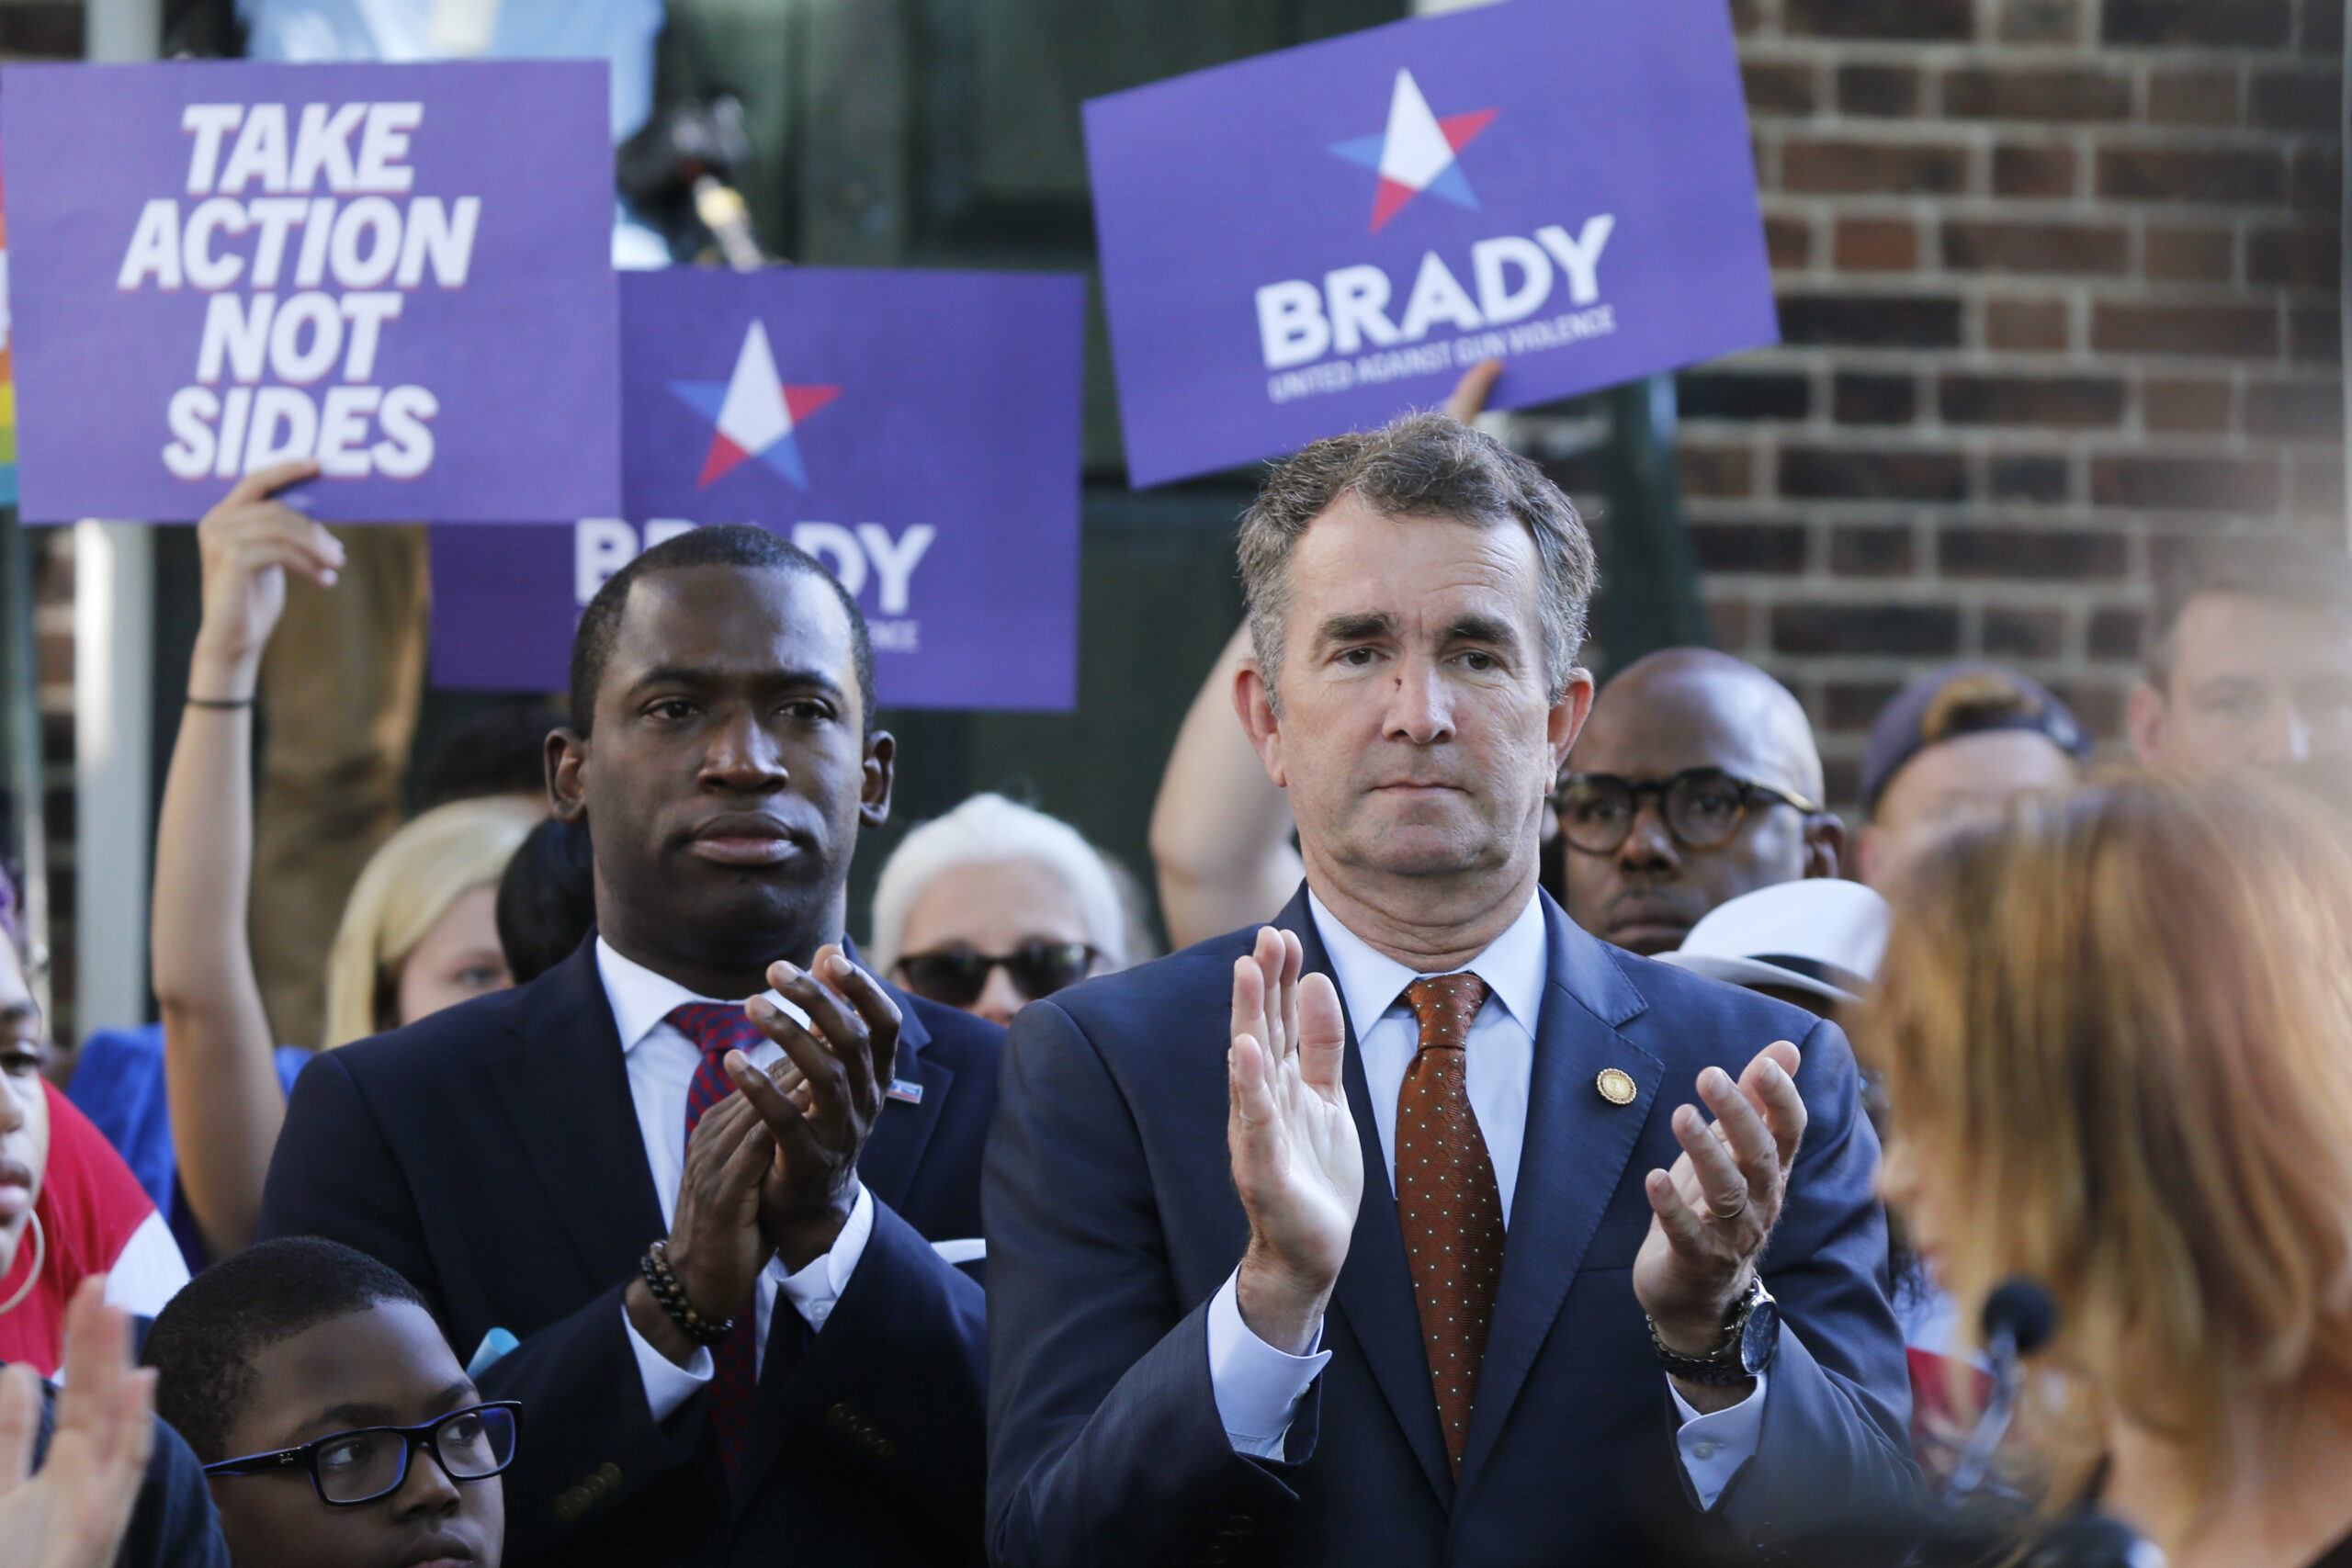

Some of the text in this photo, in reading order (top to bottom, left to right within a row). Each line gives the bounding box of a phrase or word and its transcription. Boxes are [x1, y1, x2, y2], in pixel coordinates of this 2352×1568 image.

[182, 101, 424, 194] TAKE
[117, 196, 481, 289] ACTION
[196, 290, 403, 383] NOT
[1255, 214, 1615, 369] BRADY
[1268, 304, 1617, 402] UNITED AGAINST GUN VIOLENCE
[162, 384, 438, 478] SIDES
[574, 517, 935, 615] BDY
